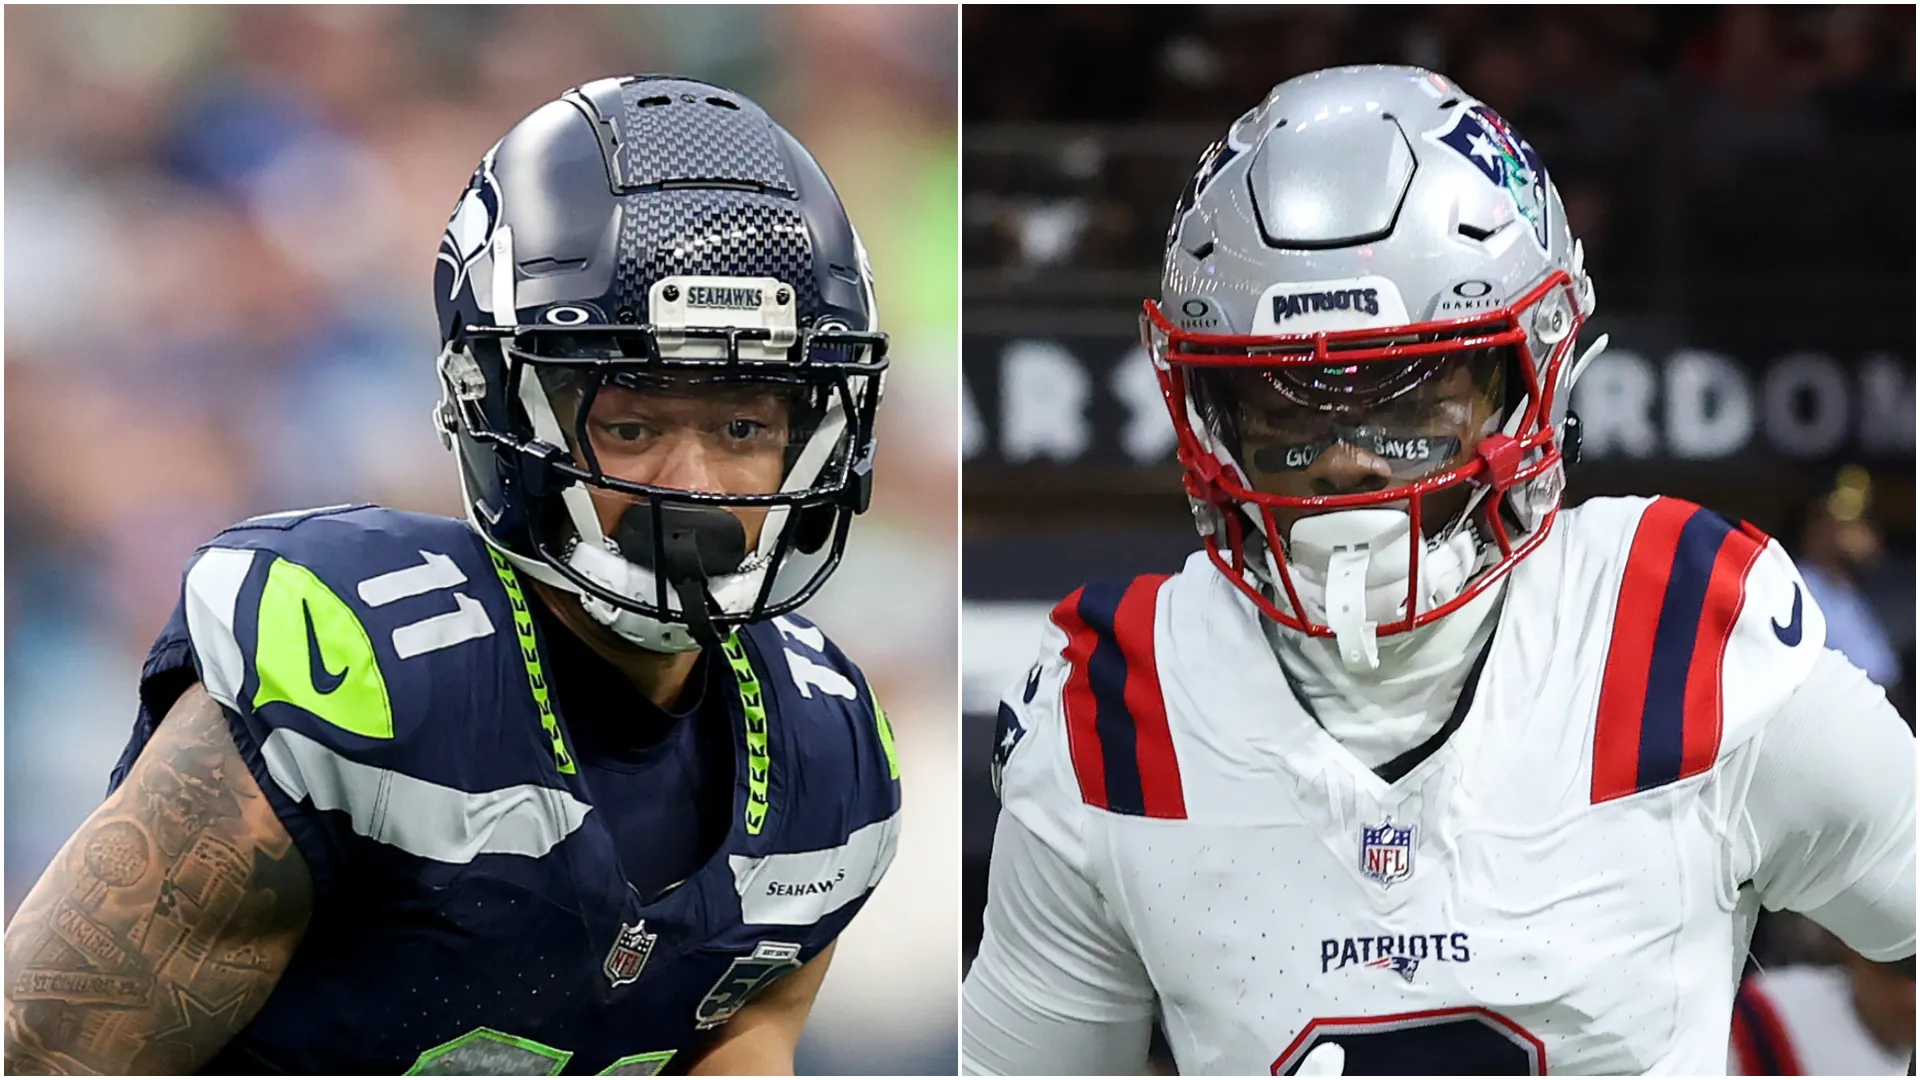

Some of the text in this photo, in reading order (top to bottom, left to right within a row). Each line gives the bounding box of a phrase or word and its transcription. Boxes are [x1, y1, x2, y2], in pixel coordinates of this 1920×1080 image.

[687, 286, 763, 310] SEAHAWKS
[1273, 288, 1379, 324] PATRIOTS
[1374, 434, 1430, 460] SAVES
[357, 549, 496, 660] 11
[1368, 848, 1405, 874] NFL
[766, 868, 845, 896] SEAHAWS
[1321, 932, 1470, 973] PATRIOTS
